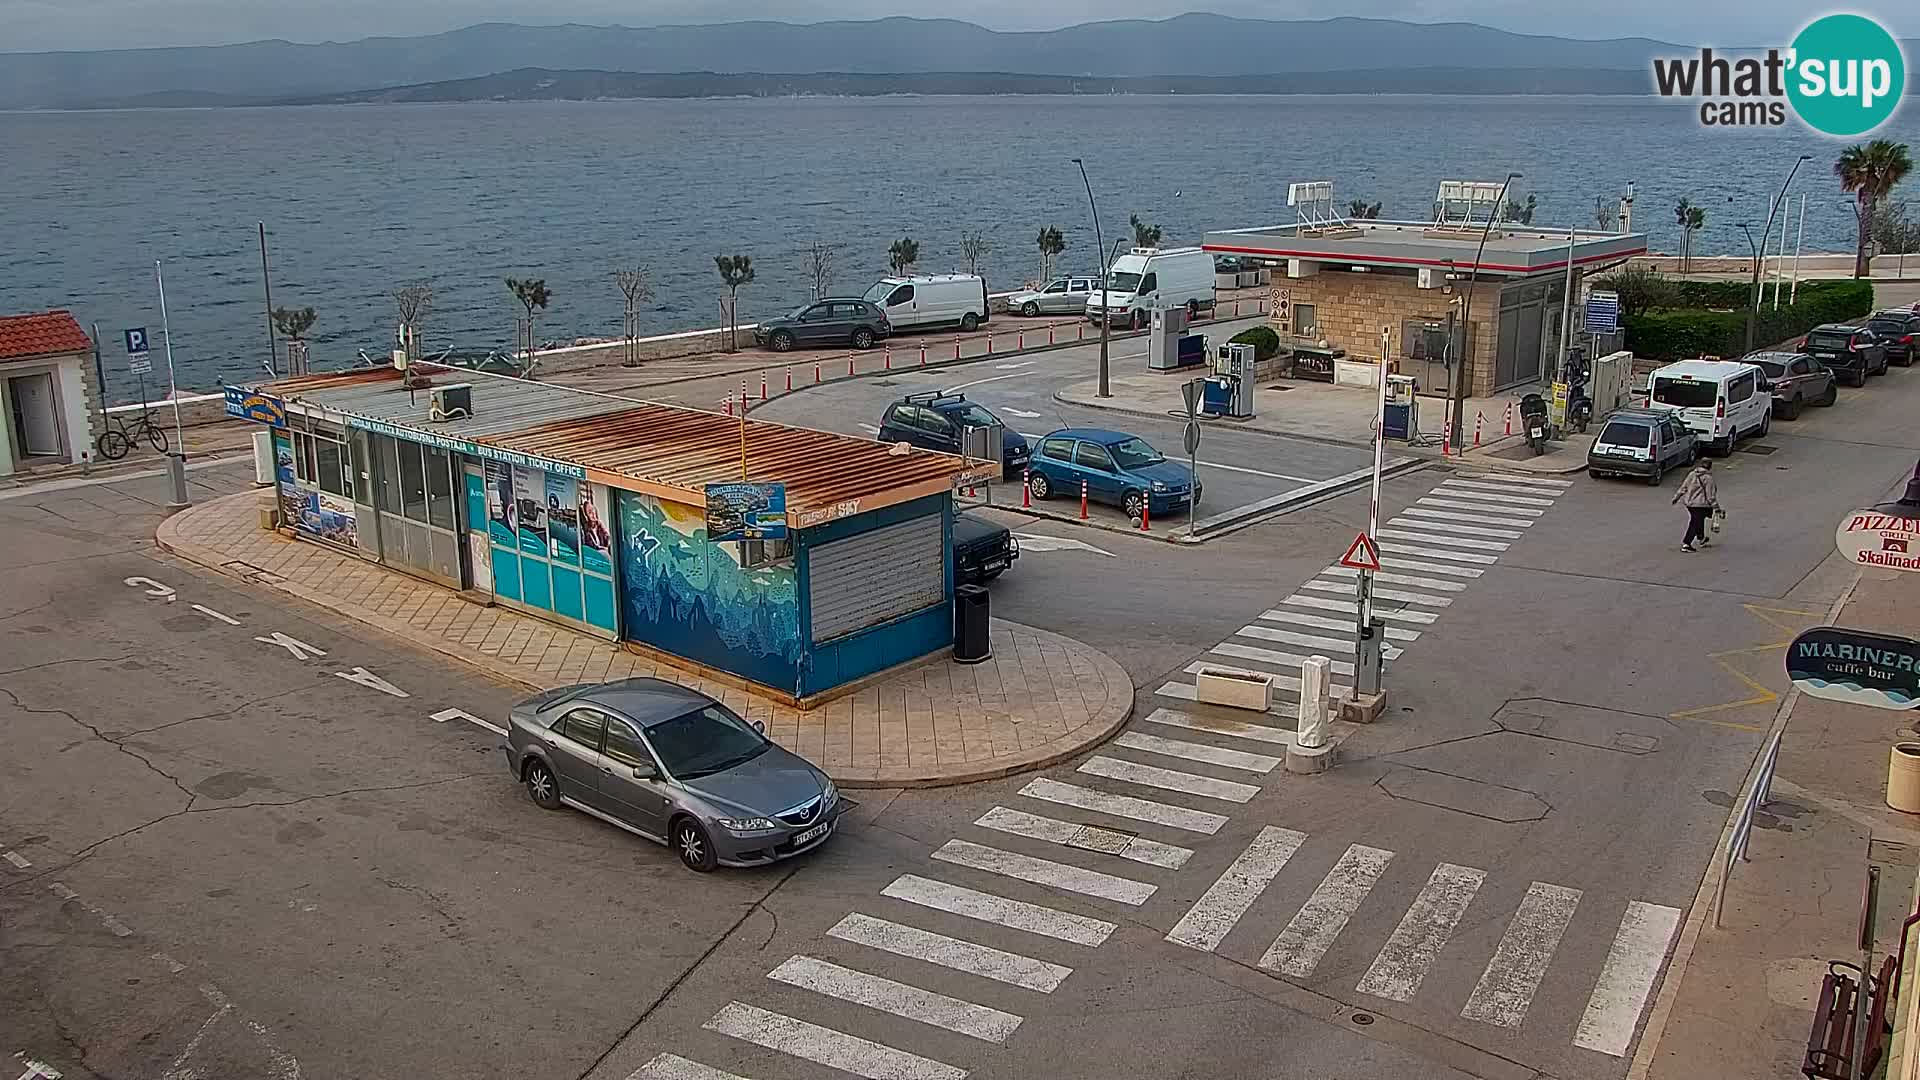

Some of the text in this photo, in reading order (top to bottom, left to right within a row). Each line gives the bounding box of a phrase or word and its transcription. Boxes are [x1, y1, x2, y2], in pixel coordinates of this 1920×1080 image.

[130, 331, 143, 350] P
[395, 426, 436, 445] AUTOBUSNA
[435, 437, 468, 452] POSTAJA
[477, 446, 493, 459] BUS
[493, 449, 526, 464] STATION
[528, 456, 555, 471] TICKET
[555, 463, 582, 477] OFFICE
[1879, 530, 1915, 541] GRILL
[1827, 662, 1895, 680] caffe bar
